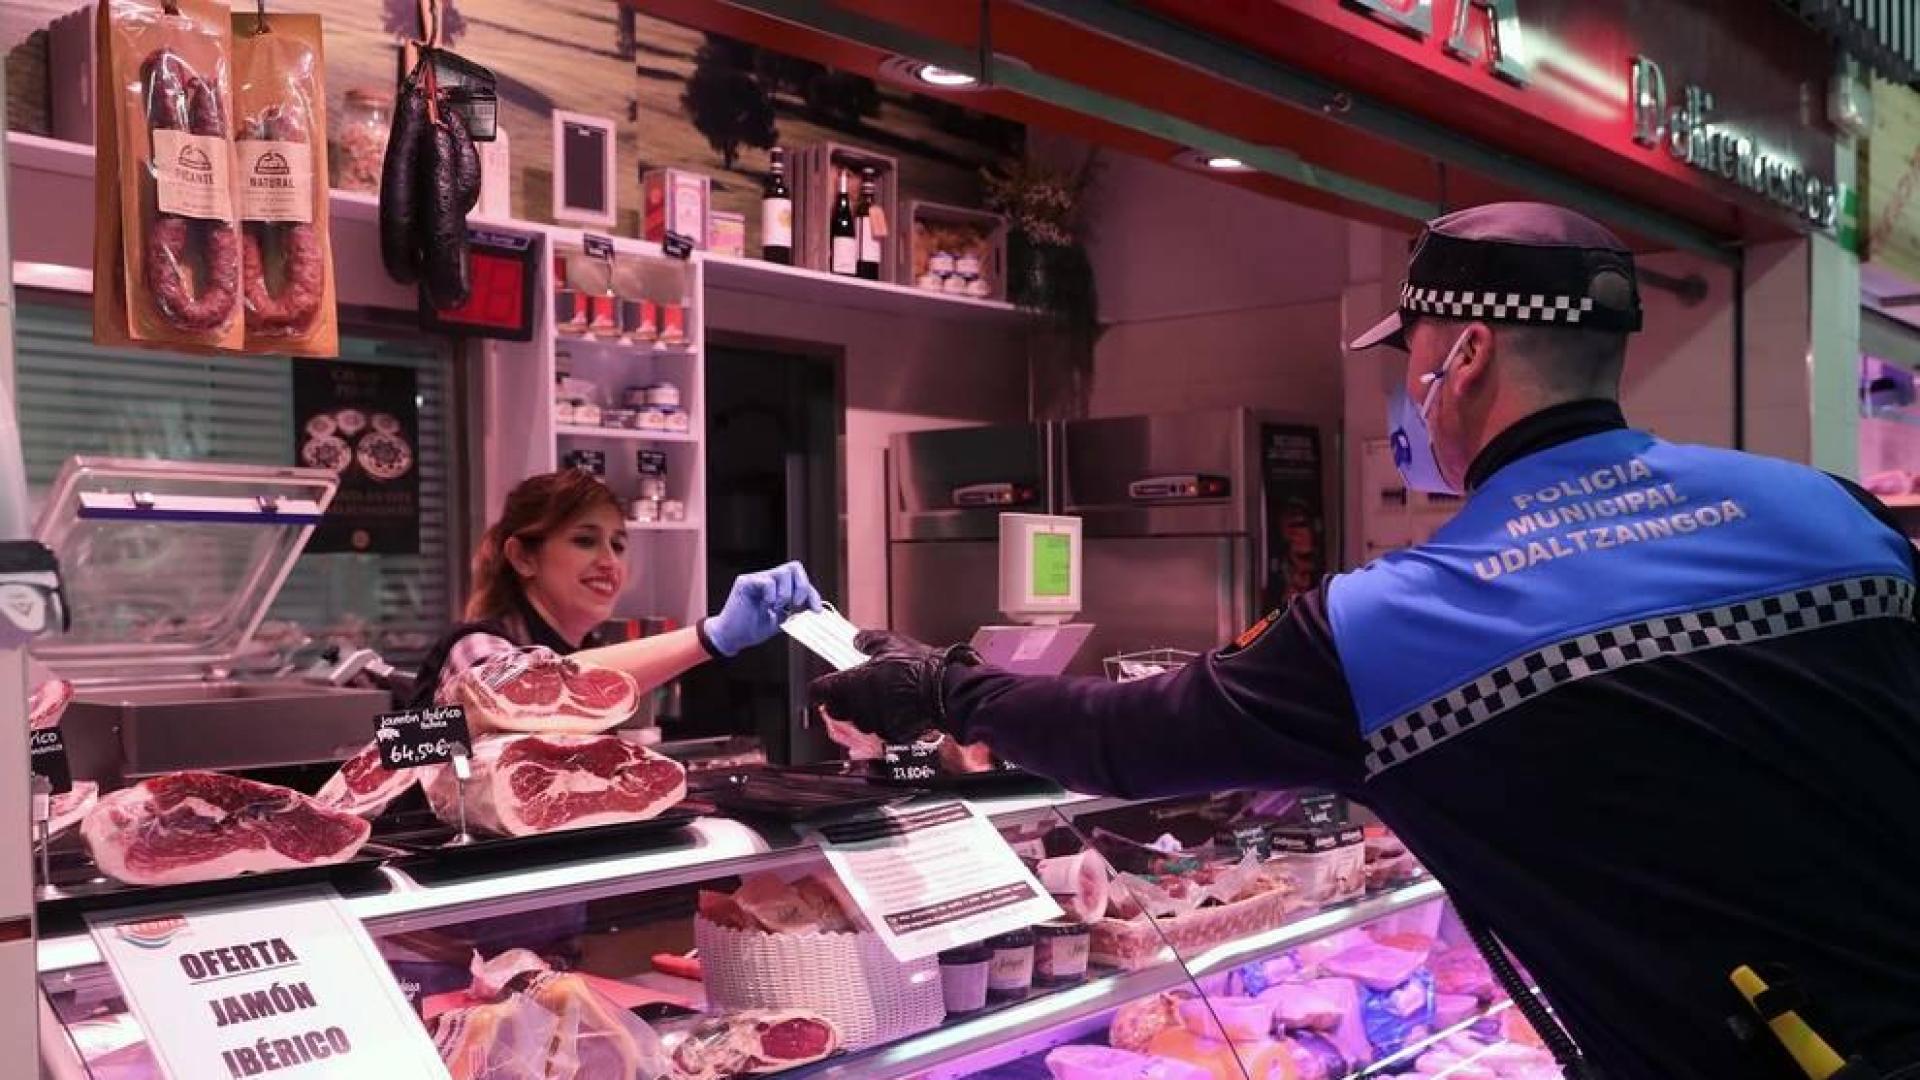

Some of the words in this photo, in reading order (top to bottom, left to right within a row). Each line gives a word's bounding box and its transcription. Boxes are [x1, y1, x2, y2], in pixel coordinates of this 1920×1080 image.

[250, 177, 296, 189] NATURAL
[1511, 457, 1652, 510] POLICIA
[1505, 482, 1688, 538] MUNICIPAL
[1473, 499, 1747, 582] UDALTZAINGOA
[31, 730, 58, 744] rico
[178, 937, 299, 980] OFERTA
[208, 982, 317, 1028] JAMÓN
[221, 1025, 352, 1079] IBÉRICO
